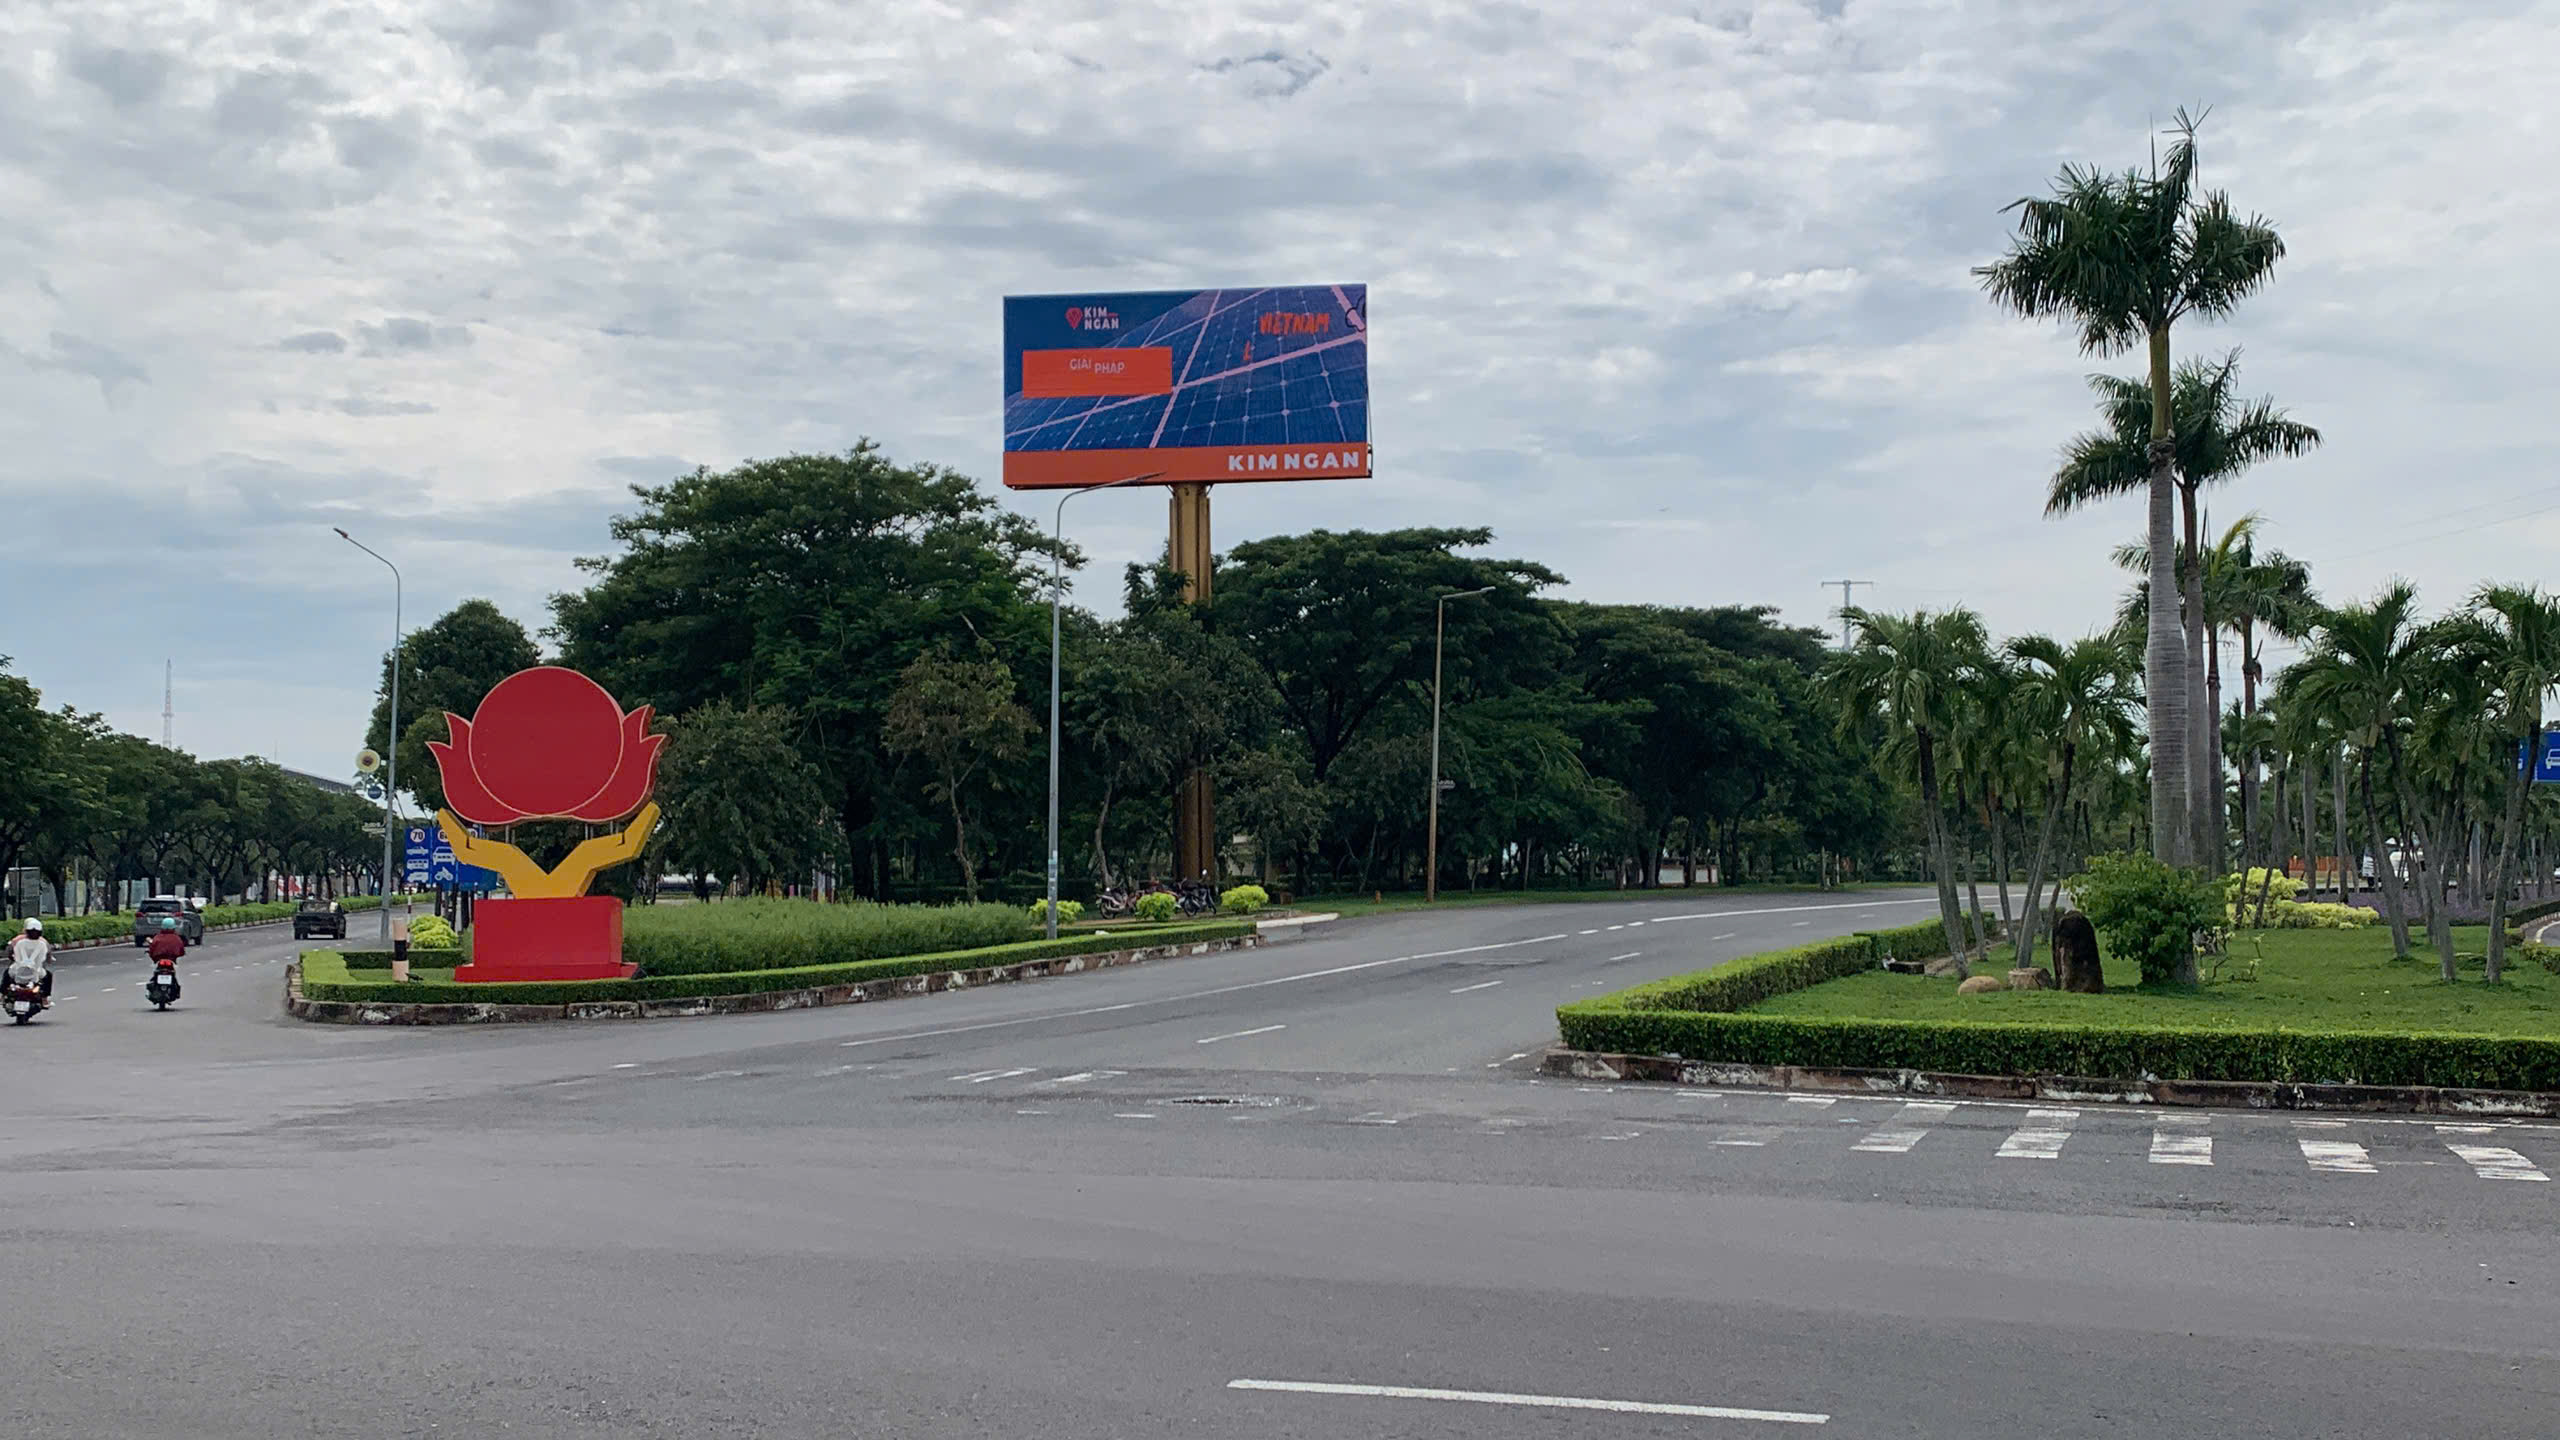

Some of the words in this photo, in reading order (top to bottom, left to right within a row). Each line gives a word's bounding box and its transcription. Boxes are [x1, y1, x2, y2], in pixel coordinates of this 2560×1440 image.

[1084, 306, 1108, 318] KIM
[1084, 318, 1120, 330] NGAN
[413, 831, 424, 840] 70
